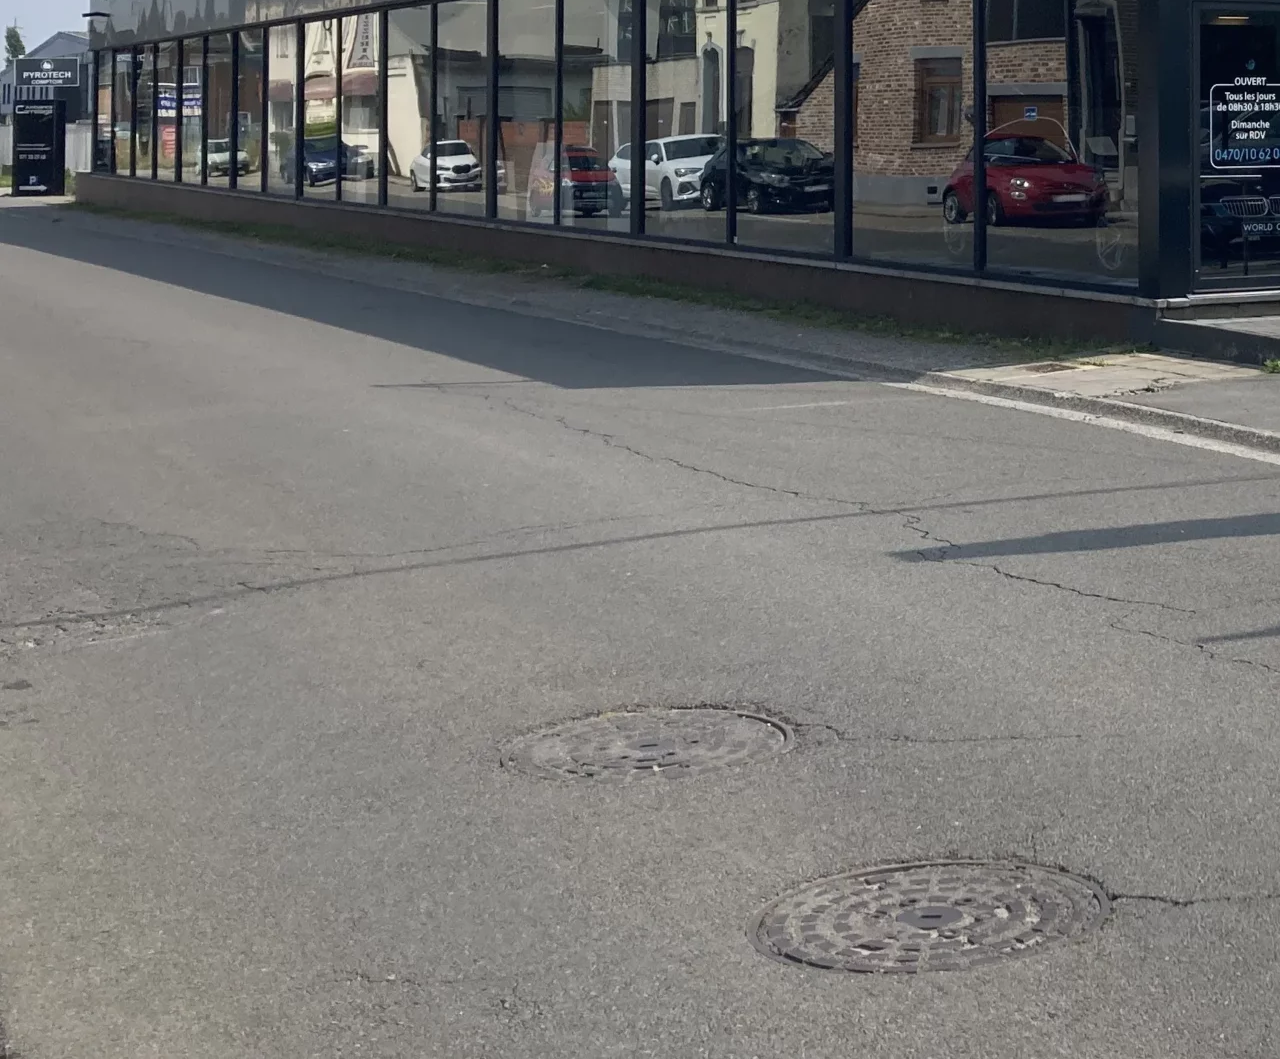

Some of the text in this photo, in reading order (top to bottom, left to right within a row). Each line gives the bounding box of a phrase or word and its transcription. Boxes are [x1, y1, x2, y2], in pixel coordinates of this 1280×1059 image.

[23, 71, 72, 79] PYROTECH
[1234, 76, 1267, 86] OUVERT
[1224, 91, 1276, 102] Tous les jours
[1216, 102, 1227, 111] de
[1228, 102, 1253, 111] 08h30
[1231, 119, 1270, 129] Dimanche
[1249, 130, 1266, 139] RDV
[1214, 148, 1257, 162] 0470/10
[1258, 148, 1271, 160] 62
[1243, 223, 1273, 231] WORLD
